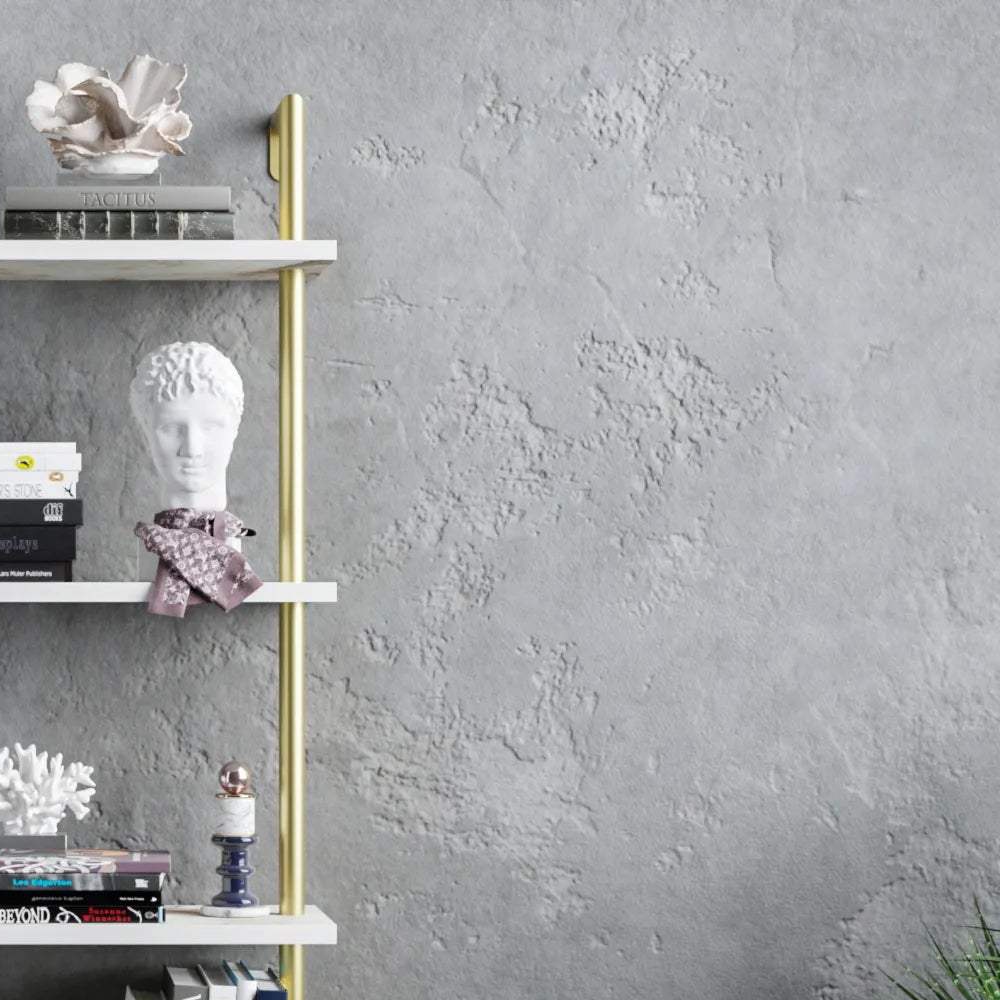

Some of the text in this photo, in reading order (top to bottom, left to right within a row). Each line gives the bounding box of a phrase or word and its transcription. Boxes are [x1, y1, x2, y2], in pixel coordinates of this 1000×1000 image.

[80, 191, 156, 208] TACITUS
[13, 484, 42, 498] STONE
[43, 502, 64, 516] dif
[12, 877, 73, 888] Les Edgerton
